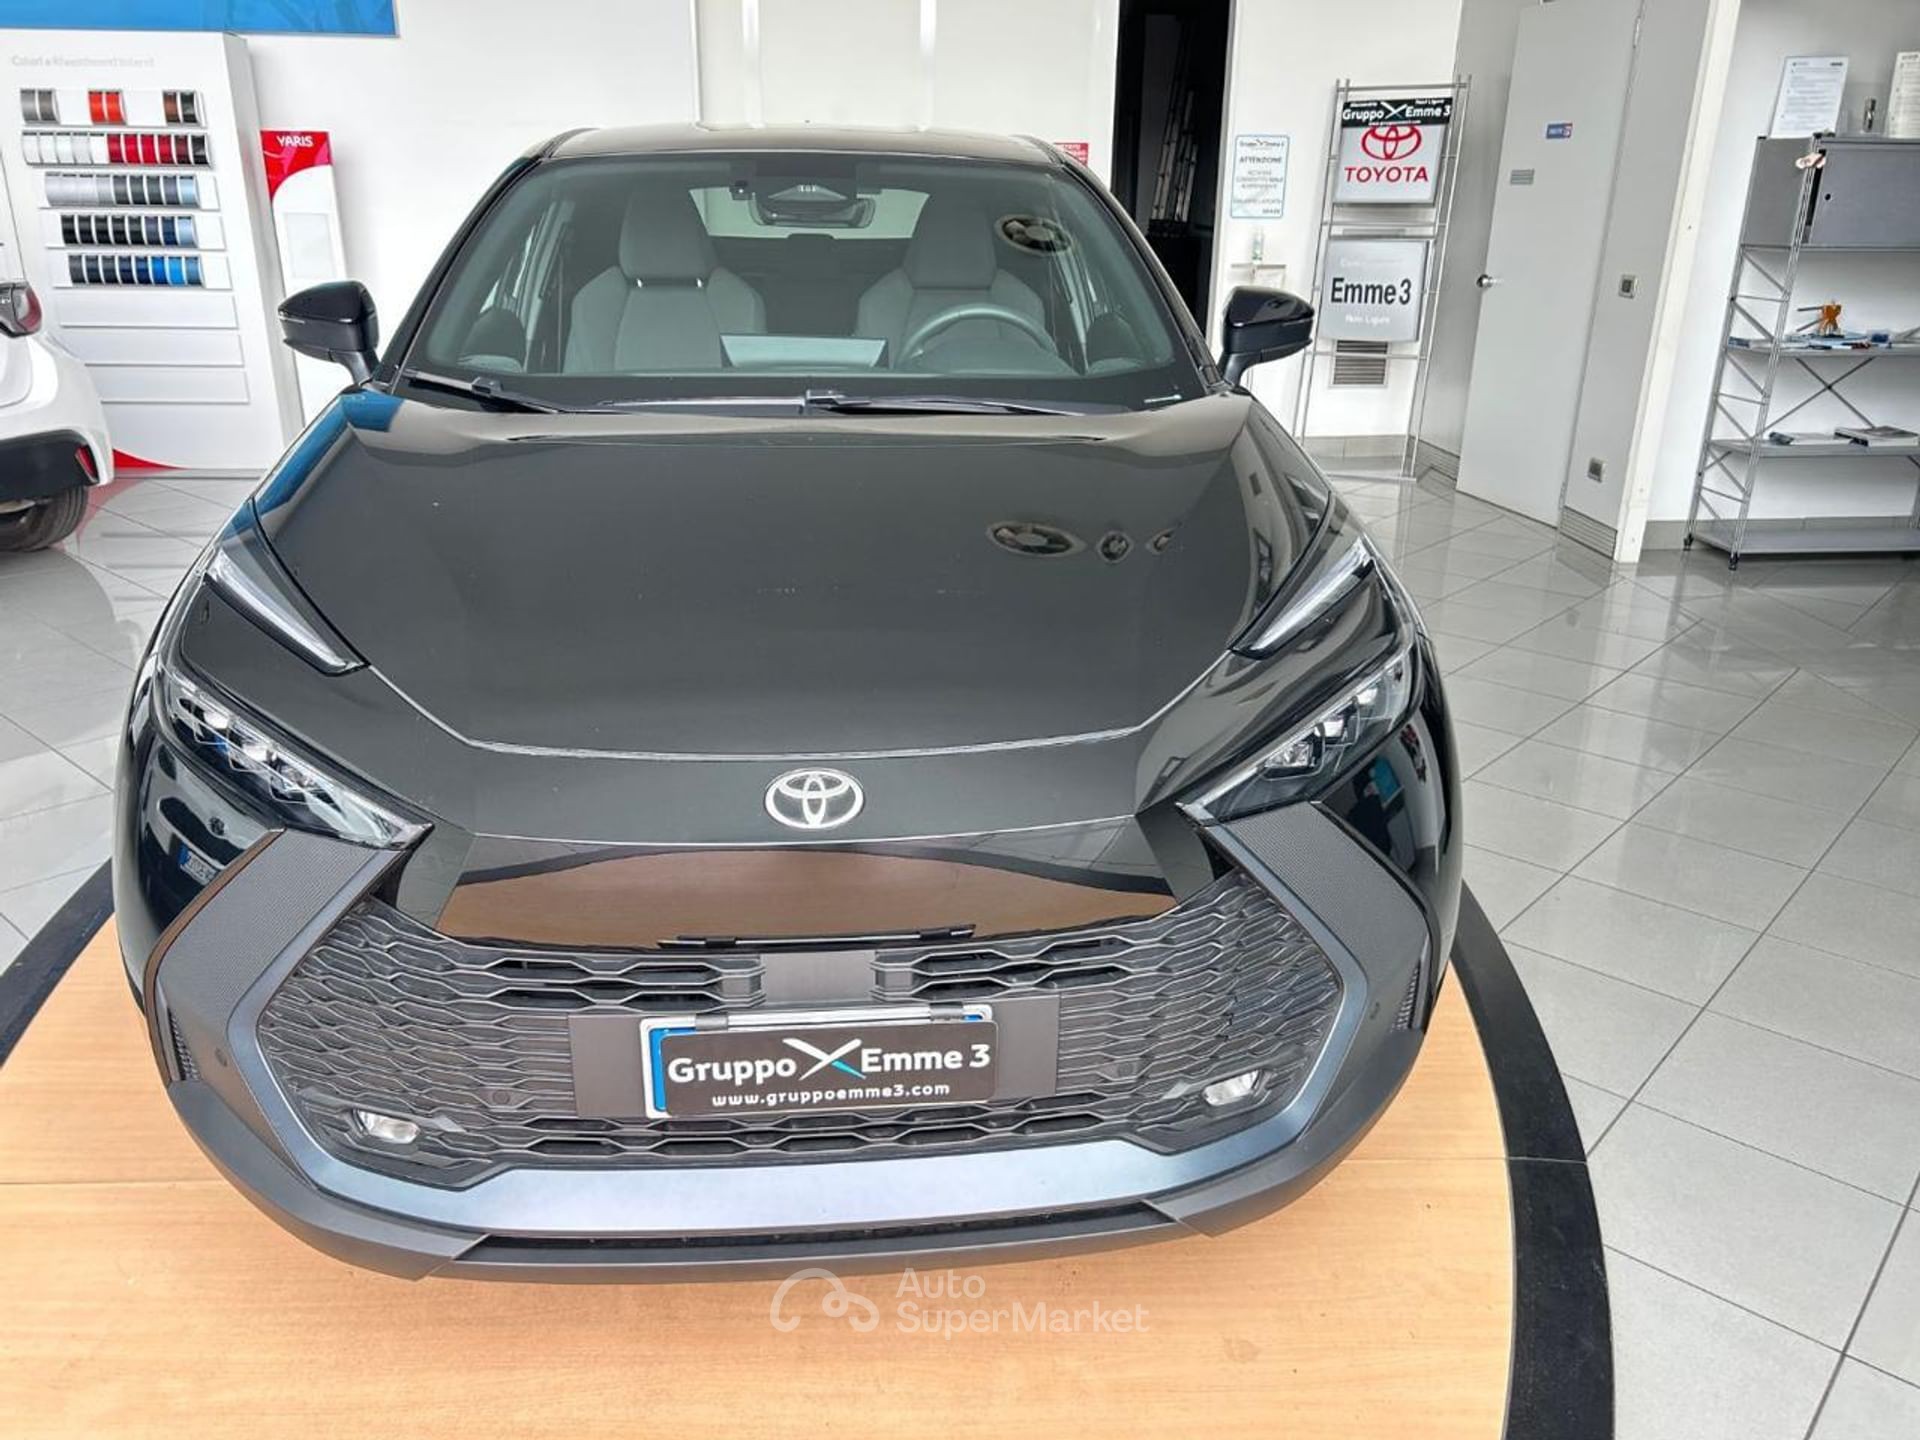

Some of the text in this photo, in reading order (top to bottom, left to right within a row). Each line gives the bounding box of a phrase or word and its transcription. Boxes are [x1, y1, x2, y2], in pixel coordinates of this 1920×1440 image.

[1342, 105, 1452, 122] Gruppo Emme 3
[277, 135, 314, 148] YARIS
[1344, 166, 1428, 183] TOYOTA
[1331, 277, 1412, 305] Emme 3
[668, 1043, 991, 1086] Gruppo Emme 3
[712, 1084, 950, 1107] www.gruppoemme3.com
